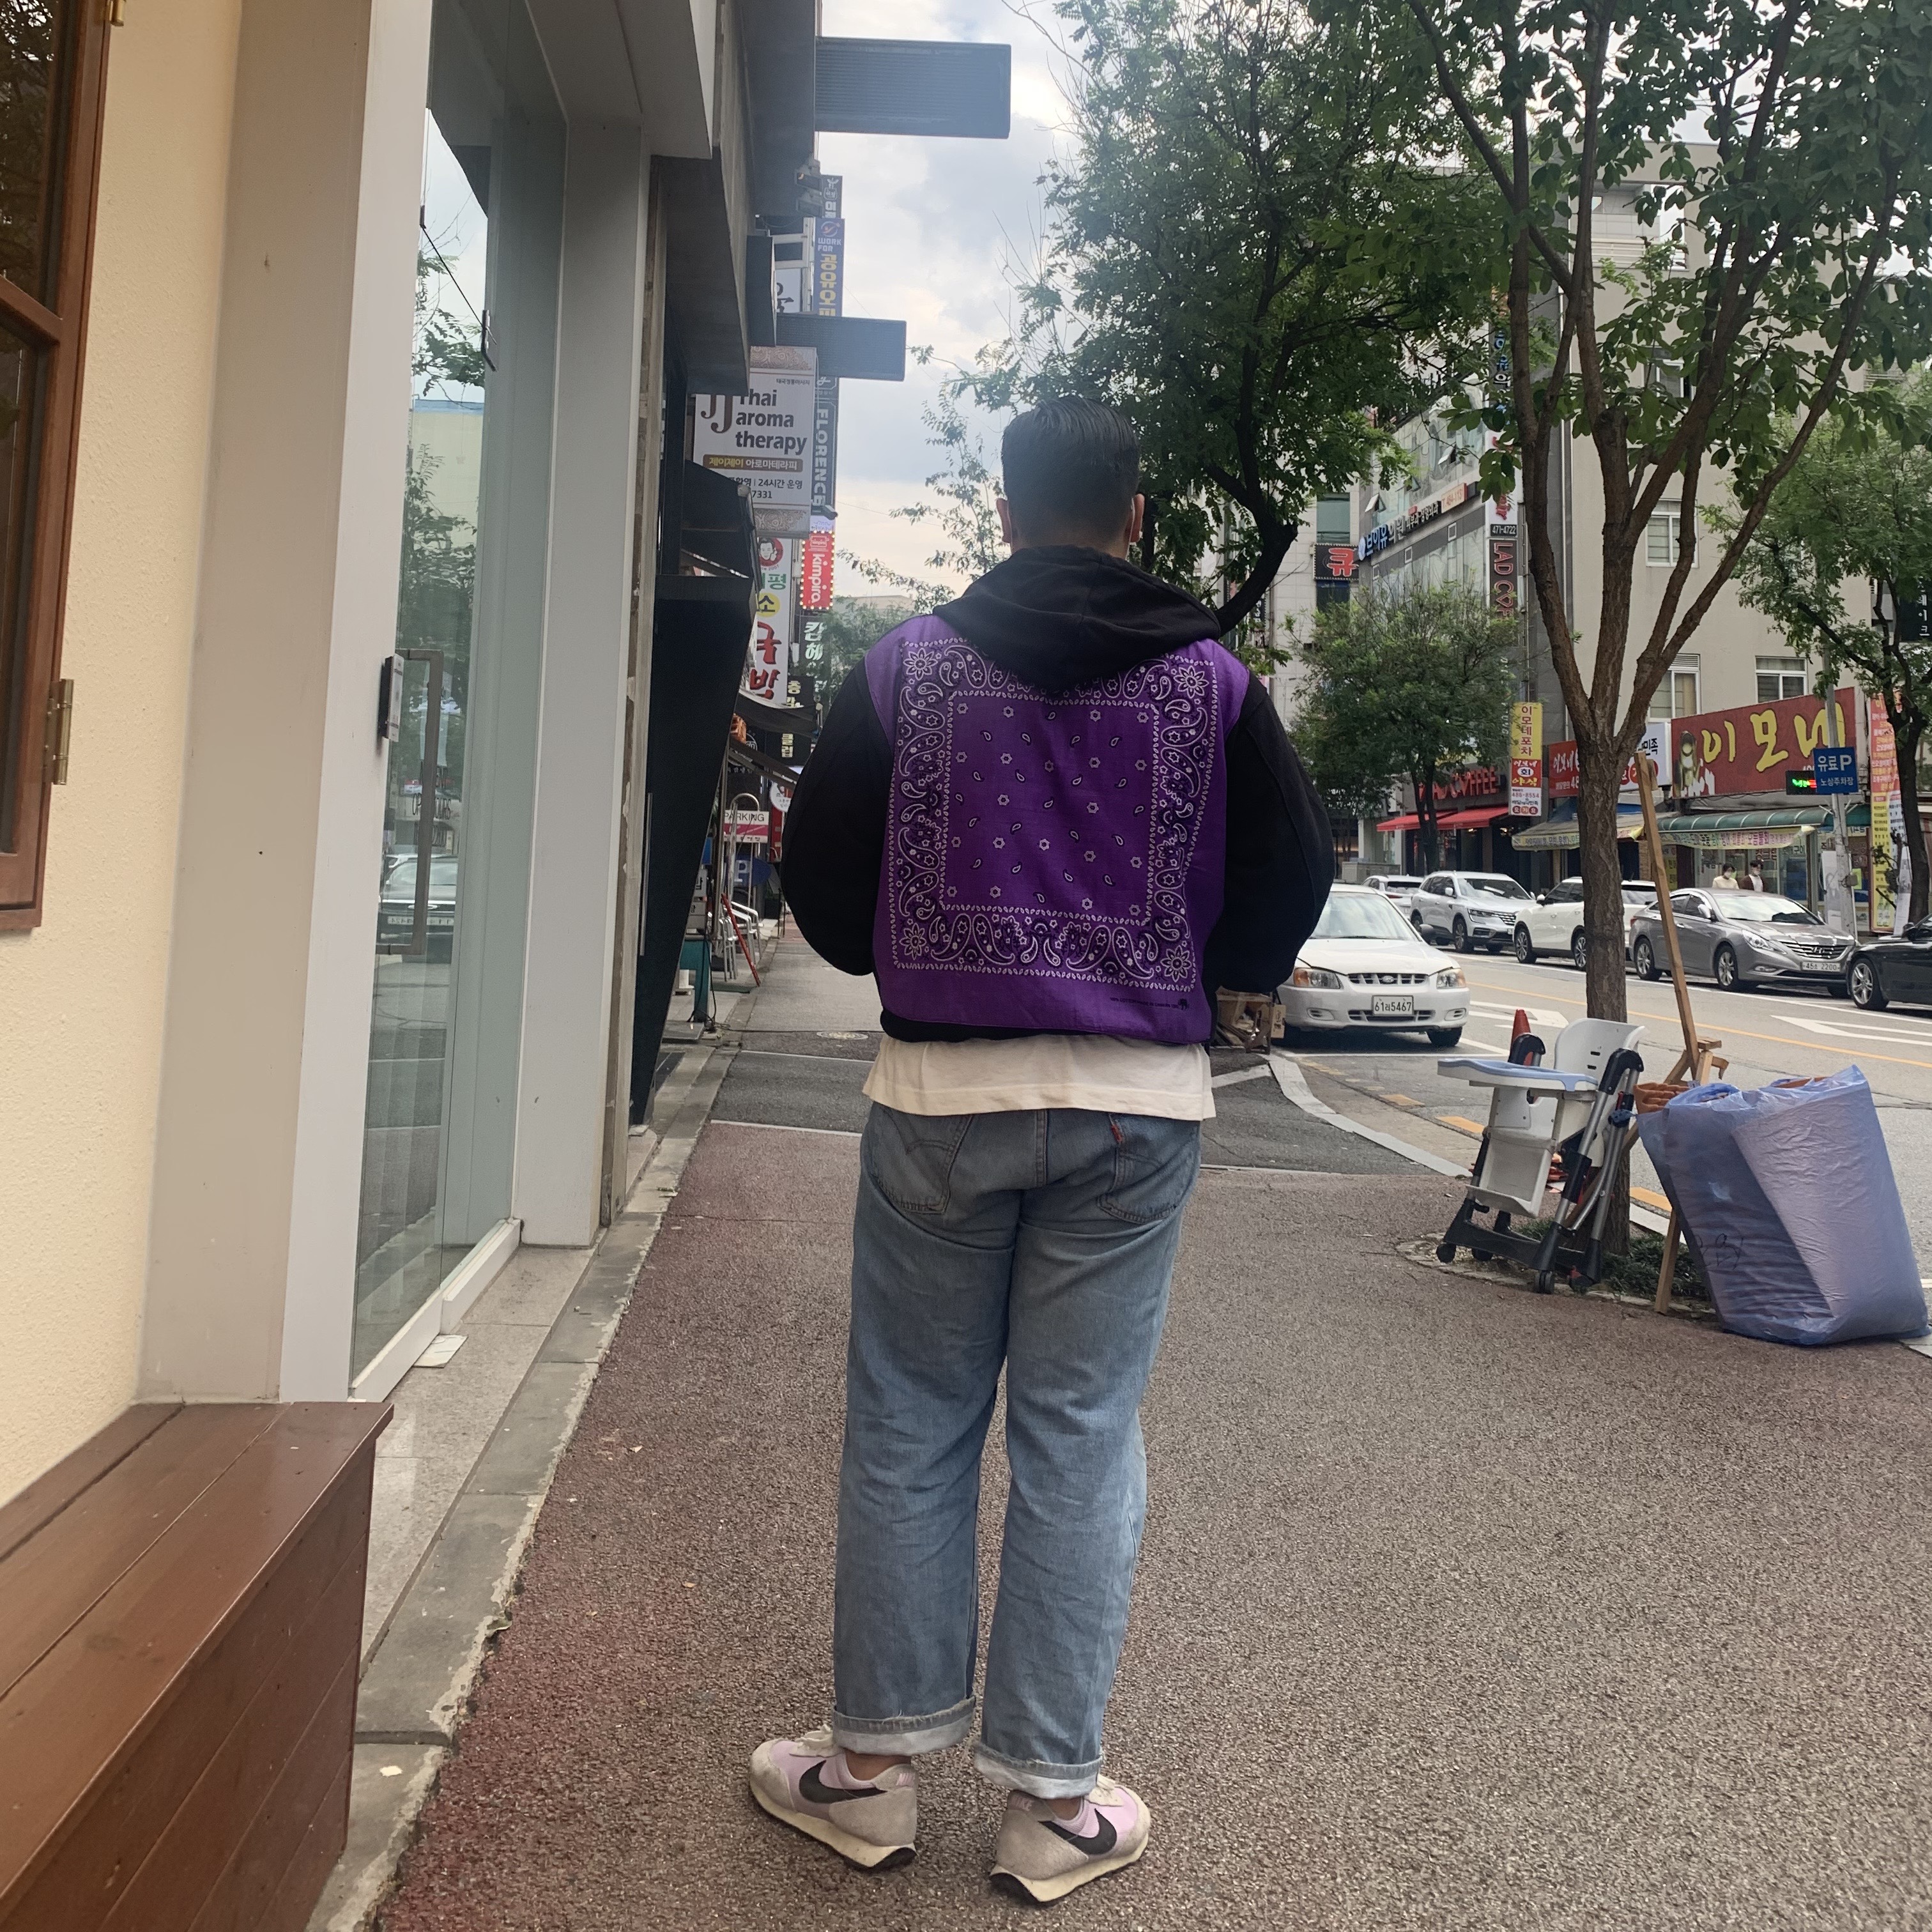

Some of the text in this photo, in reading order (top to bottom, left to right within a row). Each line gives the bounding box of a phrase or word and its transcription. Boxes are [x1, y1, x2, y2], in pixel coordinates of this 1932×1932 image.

[818, 237, 841, 245] WORK
[735, 411, 794, 427] aroma
[735, 431, 808, 455] therapy
[709, 457, 797, 471] 제이제이 아로마테라피
[812, 408, 829, 506] FLORENCE
[729, 477, 802, 489] 환영 24시간 운영
[1492, 525, 1516, 535] 471-4722
[808, 553, 828, 603] kimpira
[1638, 738, 1659, 756] 민족
[1820, 776, 1854, 786] 노상주차장
[733, 860, 750, 882] P
